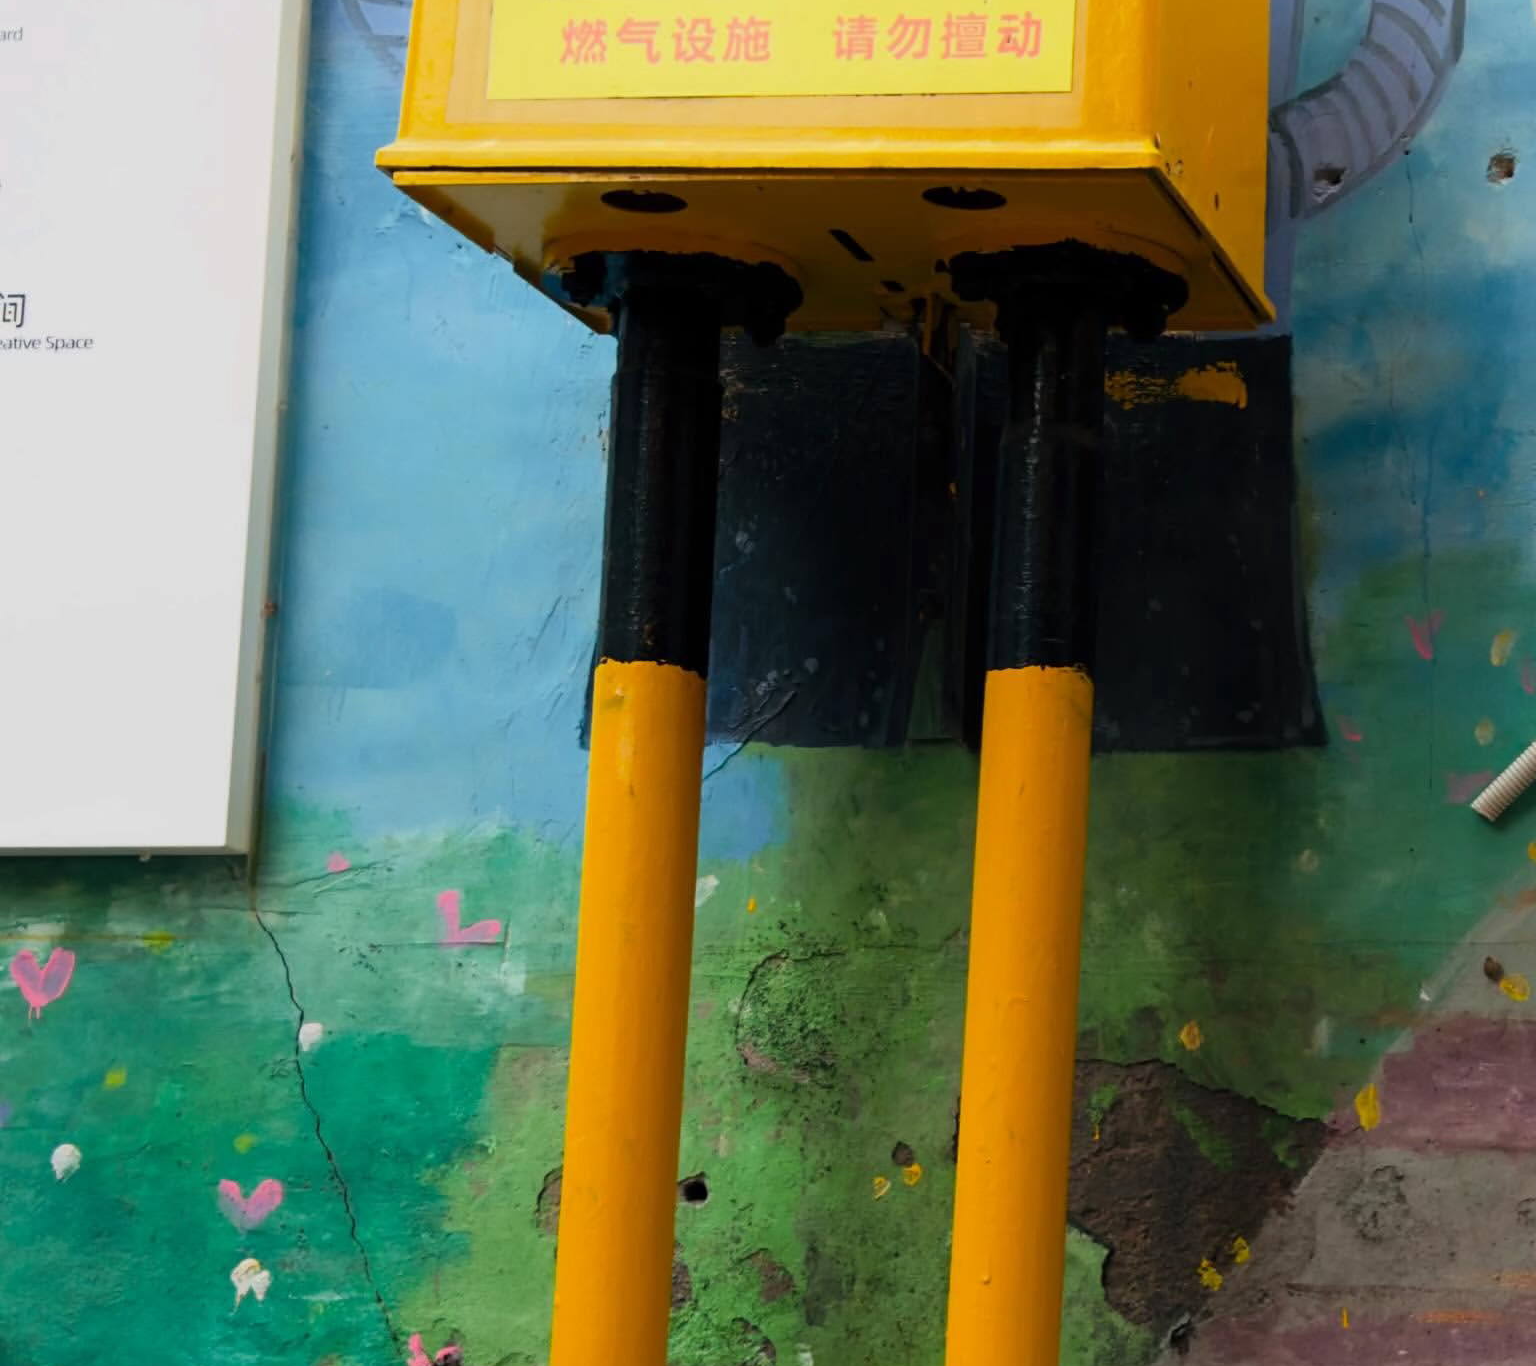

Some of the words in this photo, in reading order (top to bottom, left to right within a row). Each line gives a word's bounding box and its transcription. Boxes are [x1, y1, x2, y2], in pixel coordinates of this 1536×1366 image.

[560, 16, 772, 65] 燃气设施
[832, 11, 1043, 60] 请勿擅动
[46, 336, 94, 350] Space
